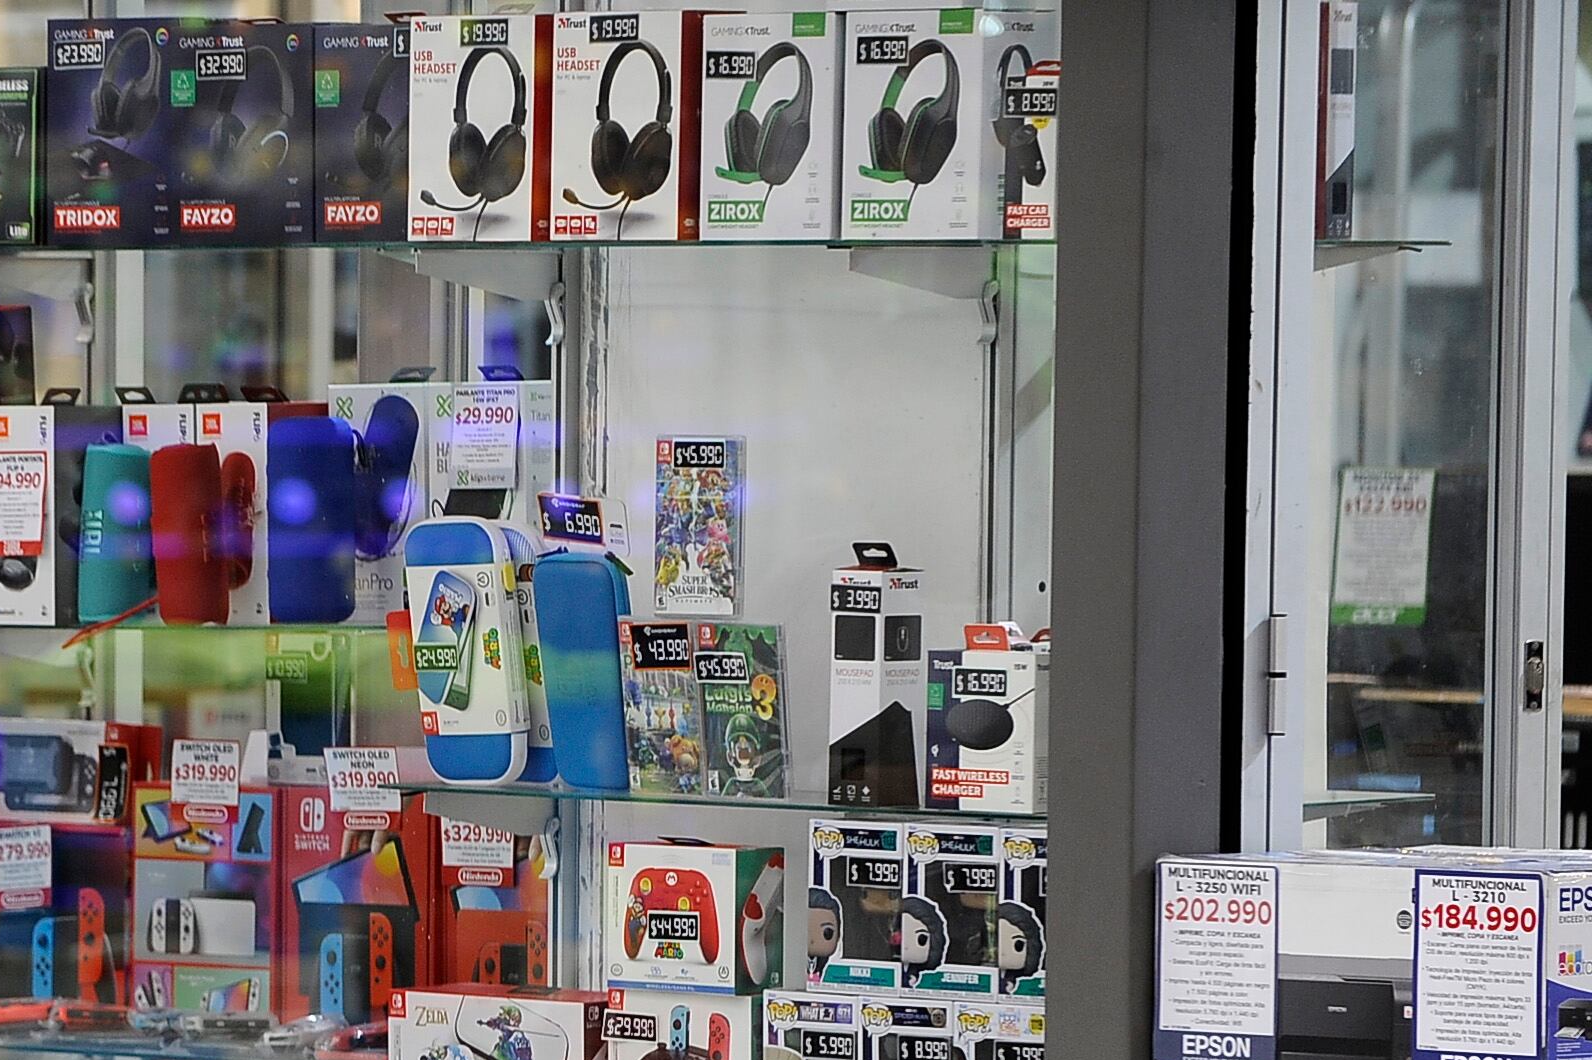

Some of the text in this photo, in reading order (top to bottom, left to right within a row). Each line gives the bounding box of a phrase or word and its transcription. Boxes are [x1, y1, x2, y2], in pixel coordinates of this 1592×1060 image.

[54, 28, 114, 40] GAMING Trust
[179, 36, 244, 48] GAMING Trust
[323, 35, 388, 48] GAMING Trust
[57, 43, 102, 63] $23.990
[414, 51, 433, 62] USB
[557, 48, 576, 58] USB
[200, 55, 243, 76] $32.990
[414, 63, 457, 74] HEADSET
[557, 60, 601, 71] HEADSET
[56, 207, 117, 227] TRIDOX
[183, 207, 233, 226] FAYZO
[327, 204, 379, 224] FAYZO
[710, 203, 761, 220] ZIROX
[853, 202, 904, 219] ZIROX
[1008, 206, 1047, 215] FAST CAR
[1008, 218, 1048, 228] CHARGER
[456, 407, 514, 425] $29.990
[676, 445, 723, 465] $45.990
[681, 575, 708, 585] SUPER
[416, 648, 457, 668] $24.990
[699, 658, 745, 678] $45.990
[836, 668, 874, 678] MOUSEPAD
[886, 668, 920, 678] MOUSEPAD
[333, 751, 390, 761] SWITCH OLED
[175, 764, 236, 781] $319.990
[351, 760, 375, 770] NEON
[332, 771, 396, 789] $319.990
[933, 770, 1007, 783] FAST WIRELESS
[933, 784, 981, 796] CHARGER
[347, 815, 386, 828] Nintendo
[444, 825, 512, 844] $329.990
[813, 831, 842, 850] POP!
[908, 836, 937, 855] POP!
[462, 871, 500, 883] Nintendo
[1168, 867, 1270, 882] MULTIFUNCIONAL
[1432, 878, 1527, 892] MULTIFUNCIONAL
[1559, 887, 1592, 911] EPS
[1164, 897, 1271, 925] $202.990
[1421, 903, 1536, 933] $184.990
[650, 917, 695, 938] $44.990
[415, 1006, 449, 1027] ZELDA
[769, 1002, 797, 1021] POP!
[862, 1007, 891, 1026] POP!
[607, 1017, 654, 1037] $29.990
[1182, 1034, 1251, 1058] EPSON
